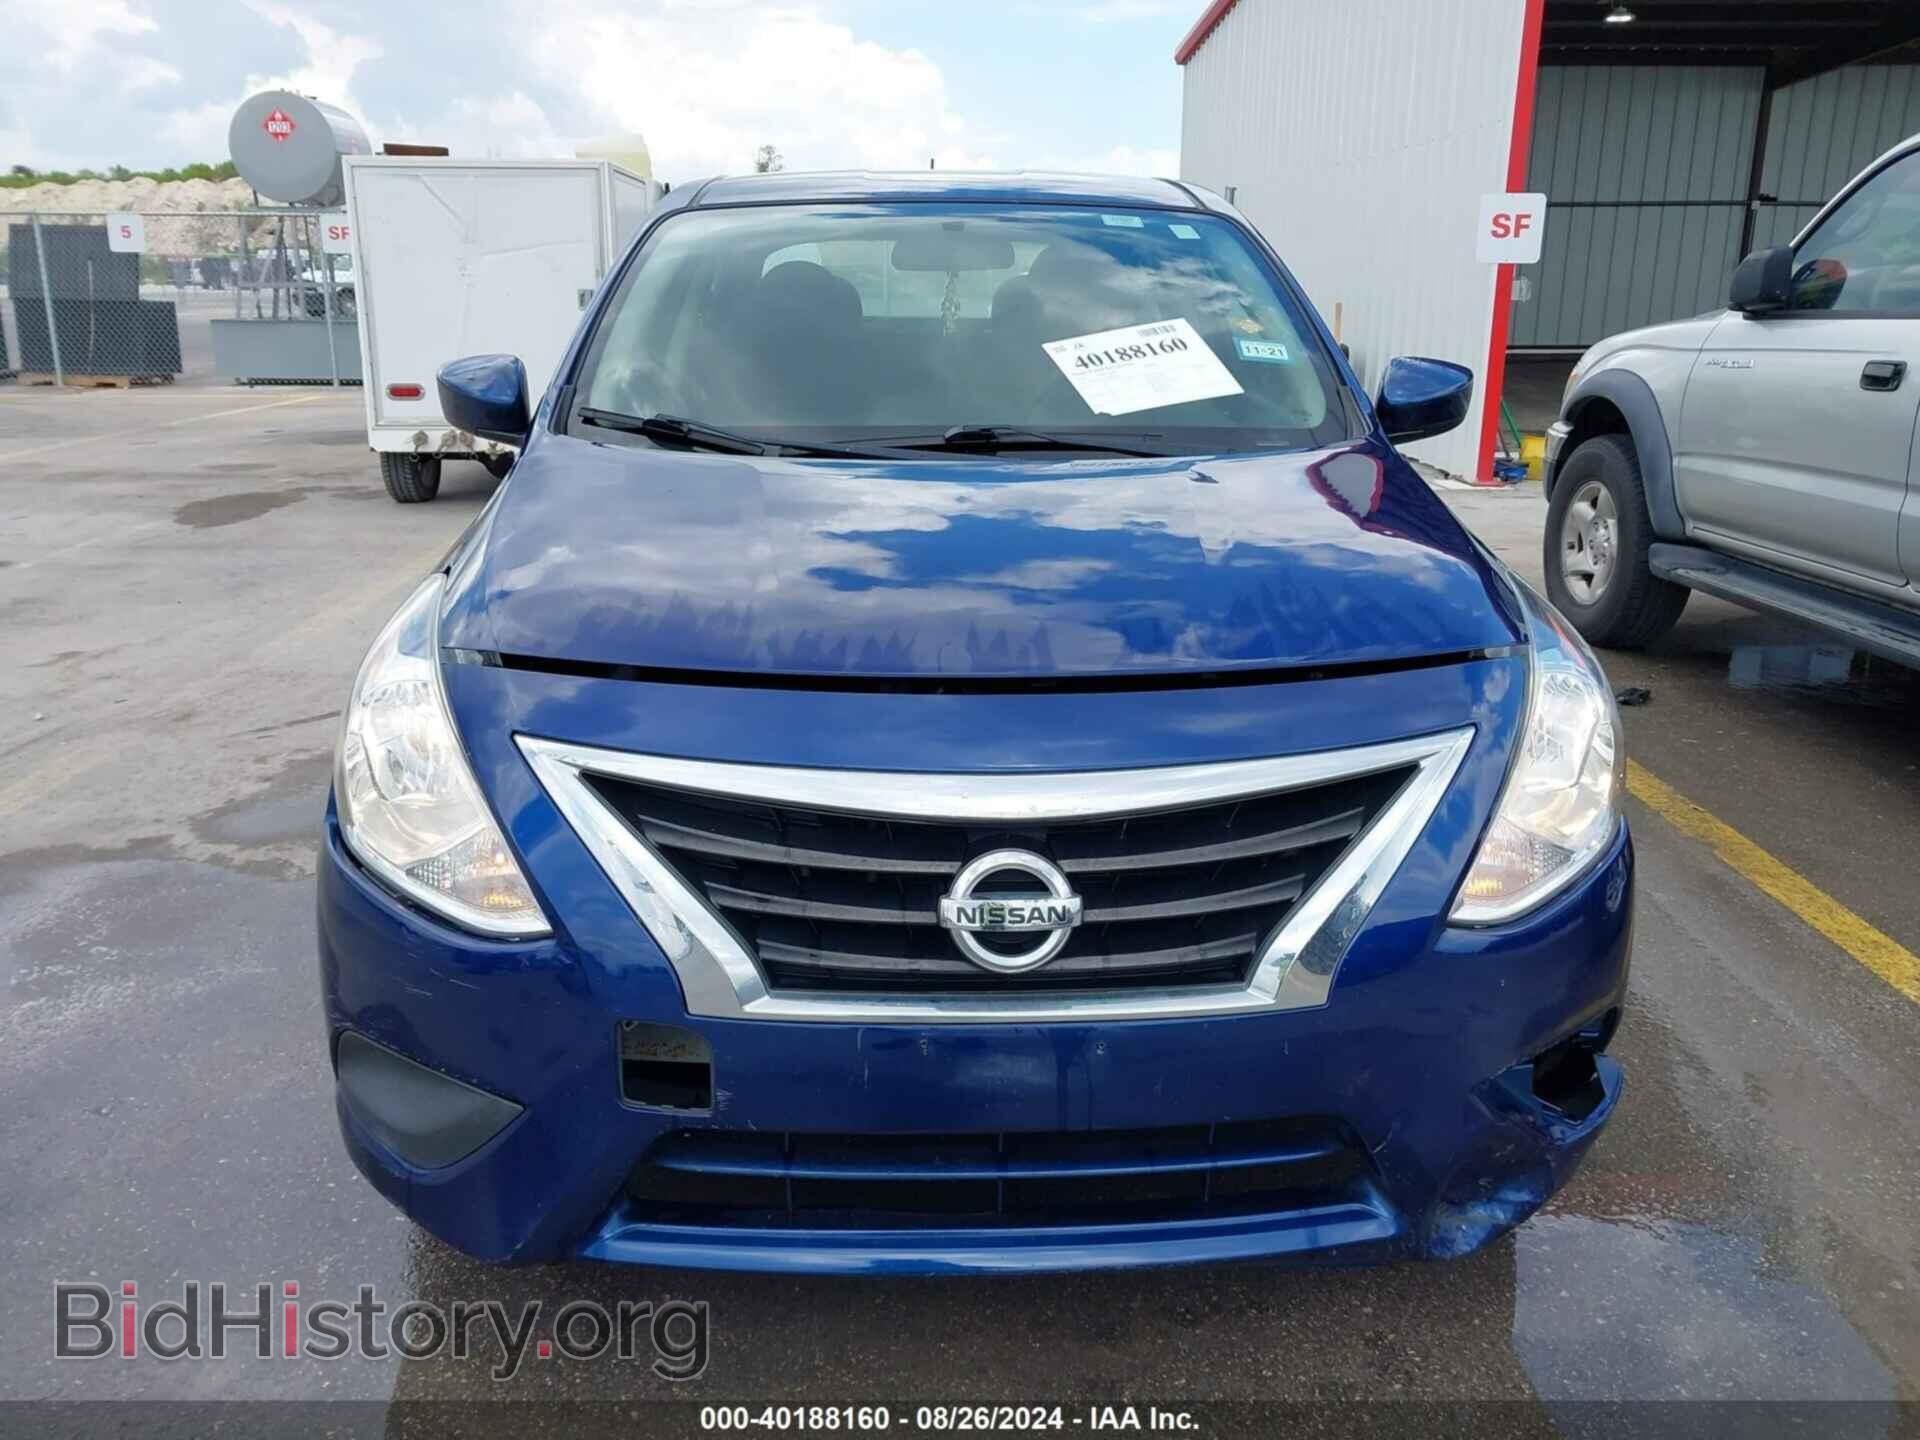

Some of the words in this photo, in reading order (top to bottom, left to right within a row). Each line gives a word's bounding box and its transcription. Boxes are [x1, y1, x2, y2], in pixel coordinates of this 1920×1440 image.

[120, 225, 132, 239] 5
[1490, 213, 1532, 239] SF
[1074, 337, 1188, 369] 40188160
[956, 905, 1067, 925] NISSAN
